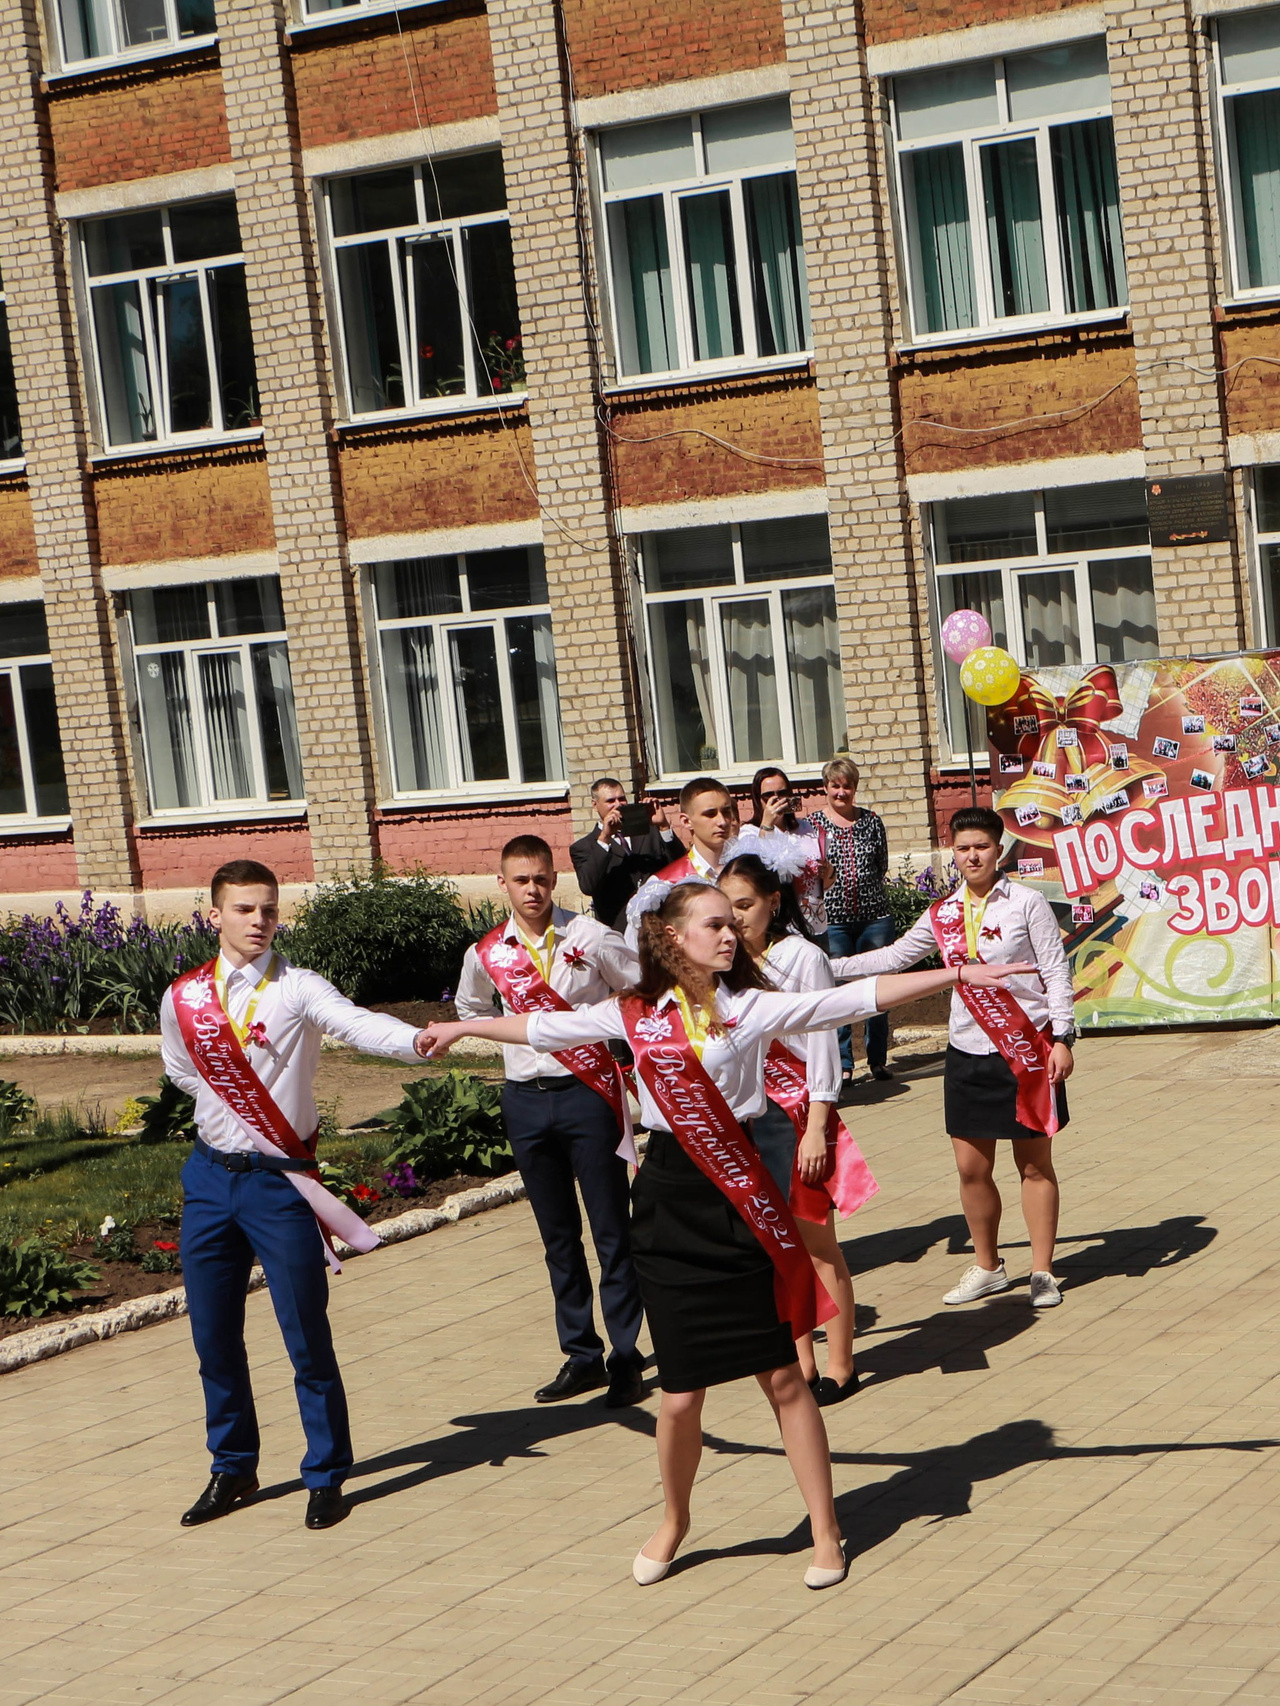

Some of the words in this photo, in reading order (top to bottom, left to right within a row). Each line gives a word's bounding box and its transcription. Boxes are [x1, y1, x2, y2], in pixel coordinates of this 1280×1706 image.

[1004, 1030, 1045, 1073] 2021
[688, 1078, 726, 1134] Ступина
[648, 1045, 754, 1190] Выпускник
[749, 1190, 797, 1250] 2021
